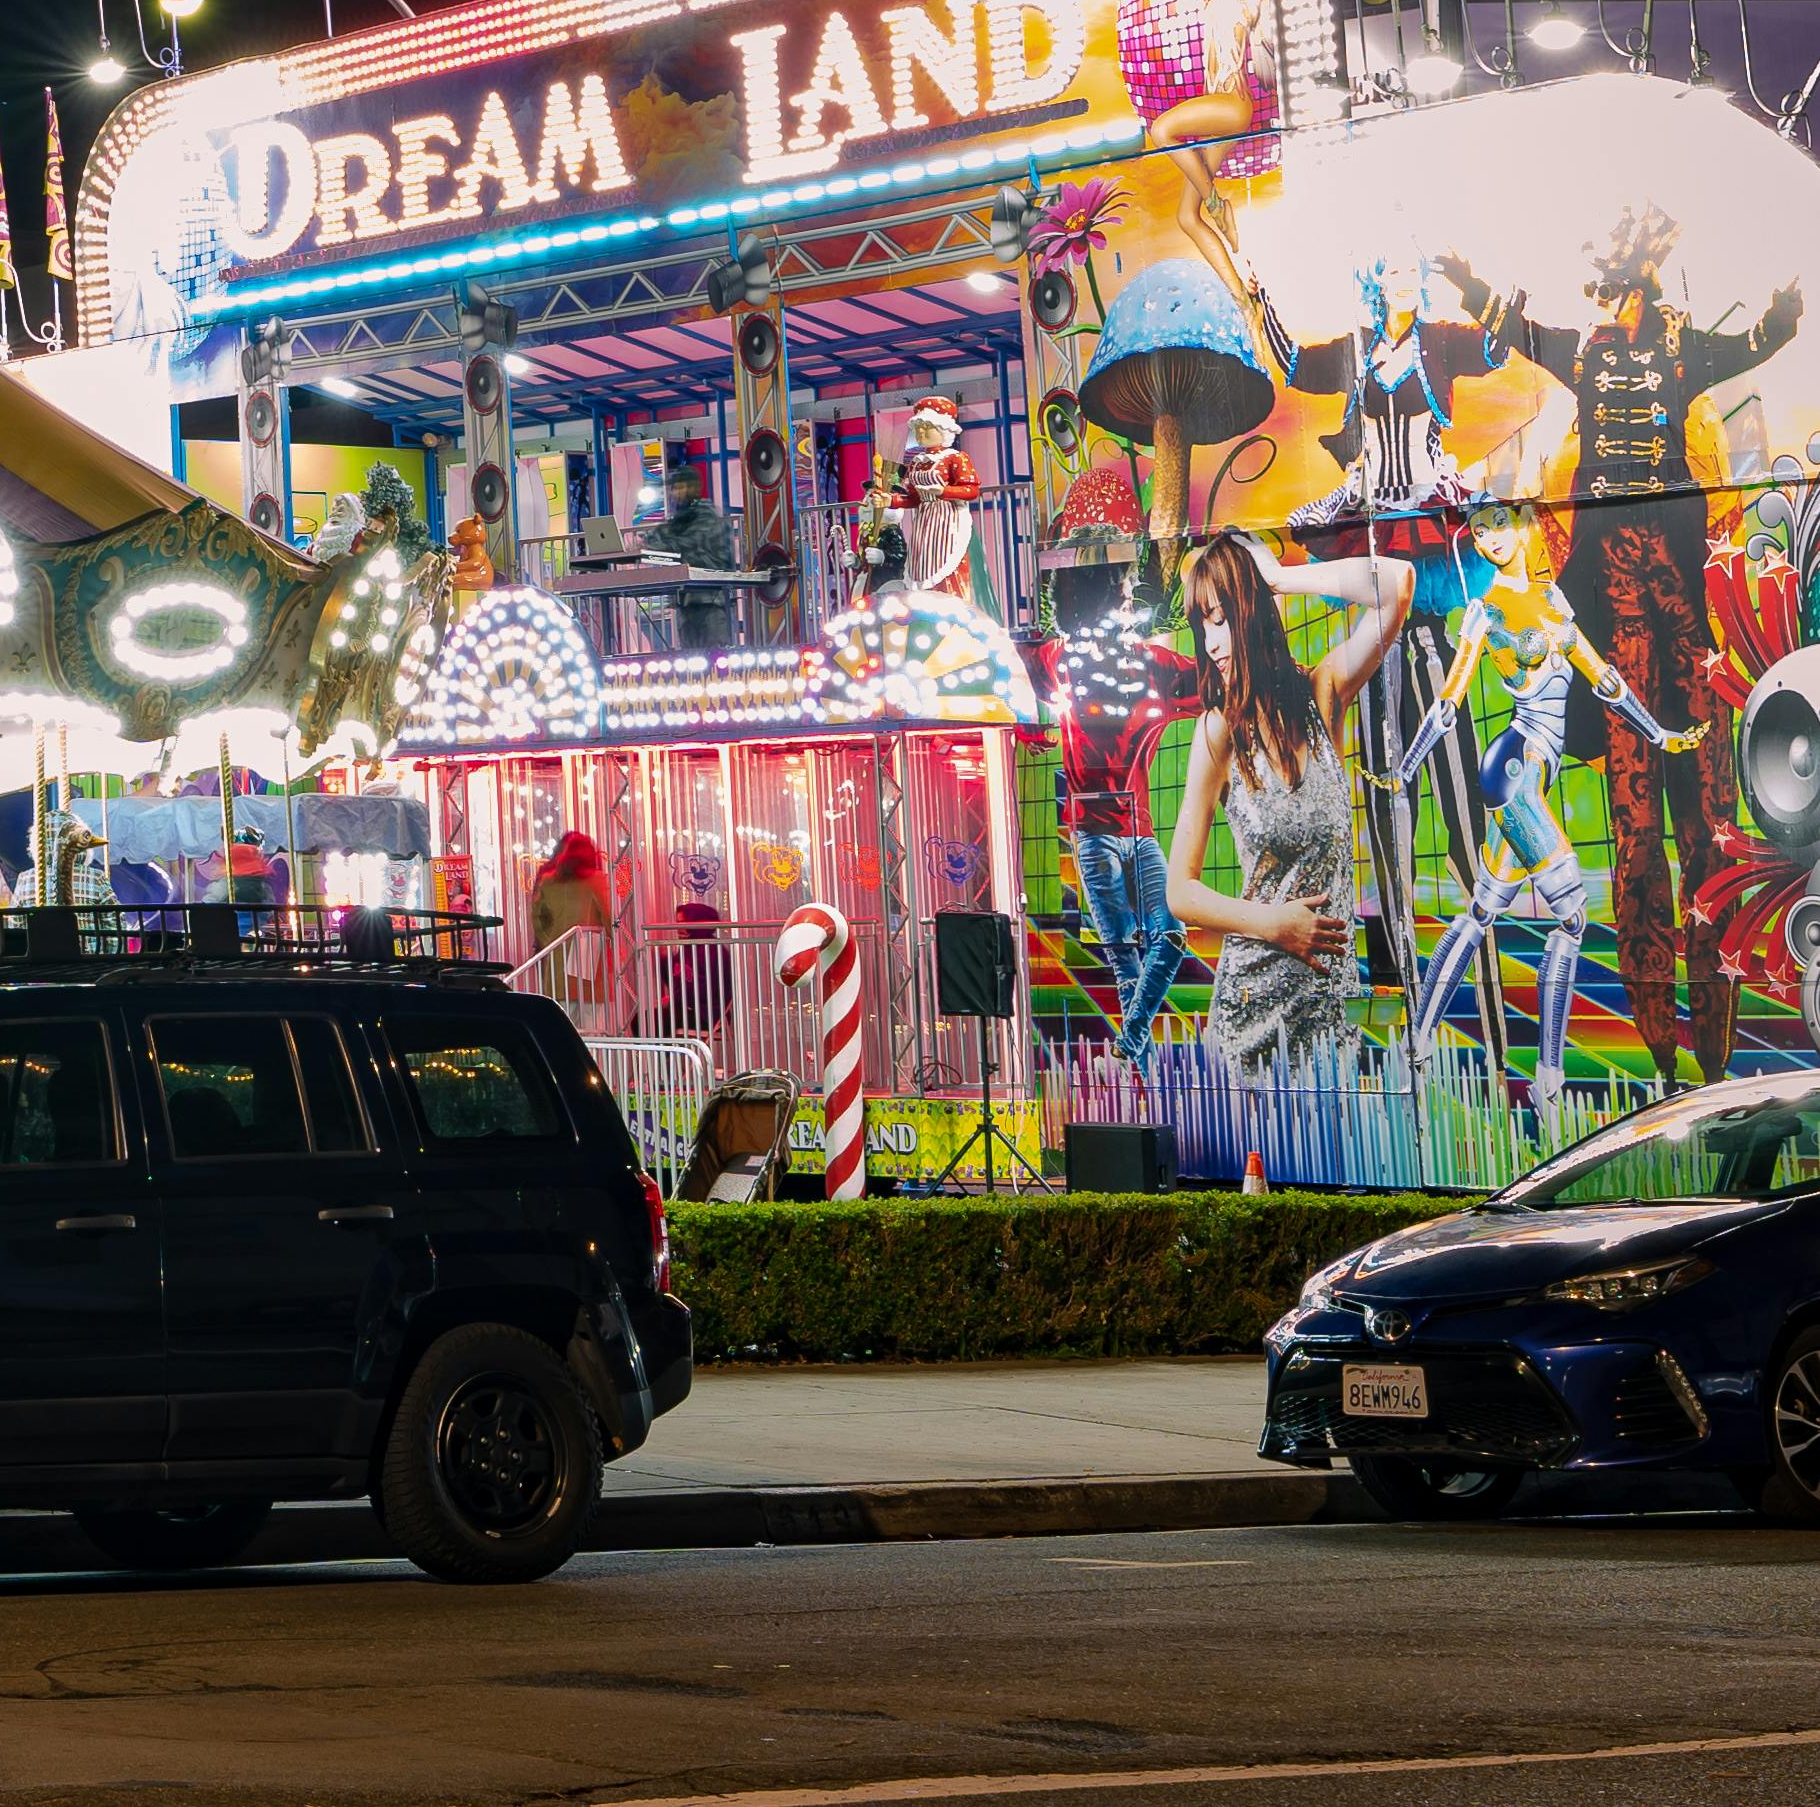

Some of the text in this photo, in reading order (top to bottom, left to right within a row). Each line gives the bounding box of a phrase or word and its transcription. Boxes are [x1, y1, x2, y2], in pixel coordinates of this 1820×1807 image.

[218, 72, 637, 261] DREAM
[864, 1122, 918, 1155] AND
[1360, 1368, 1410, 1384] California
[1349, 1383, 1421, 1410] 8EWM946
